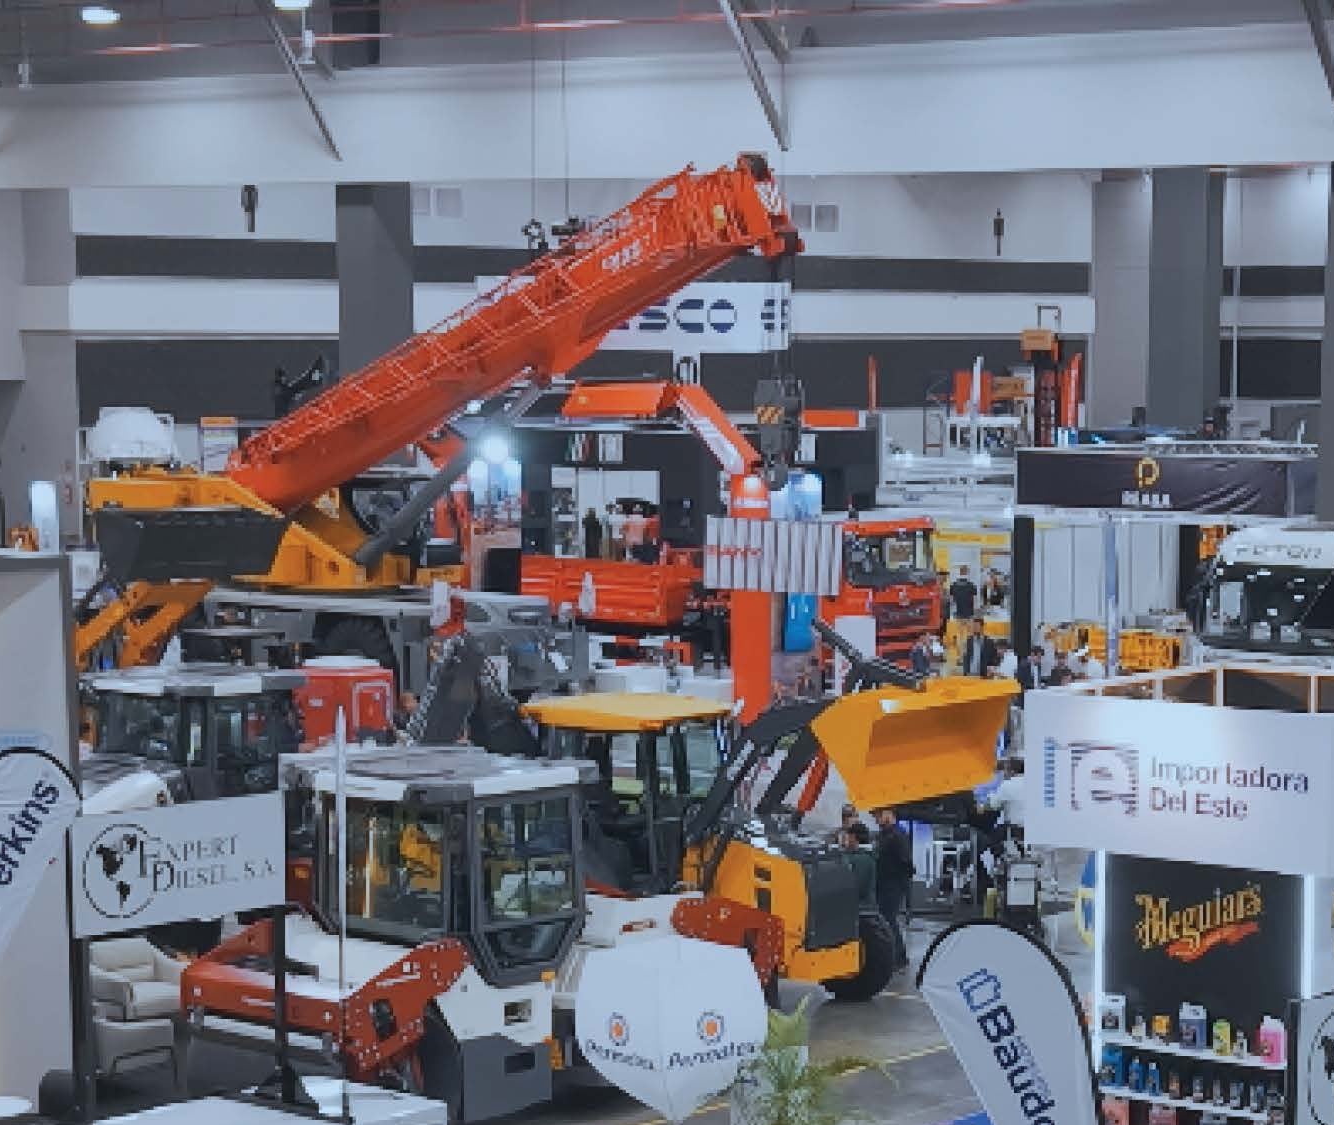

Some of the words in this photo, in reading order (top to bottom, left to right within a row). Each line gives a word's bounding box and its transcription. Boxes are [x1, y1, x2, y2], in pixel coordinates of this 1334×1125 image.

[1150, 757, 1308, 793] Importadora
[1149, 787, 1186, 814] Del
[1195, 793, 1248, 820] Este
[1134, 881, 1261, 950] Meguiar's
